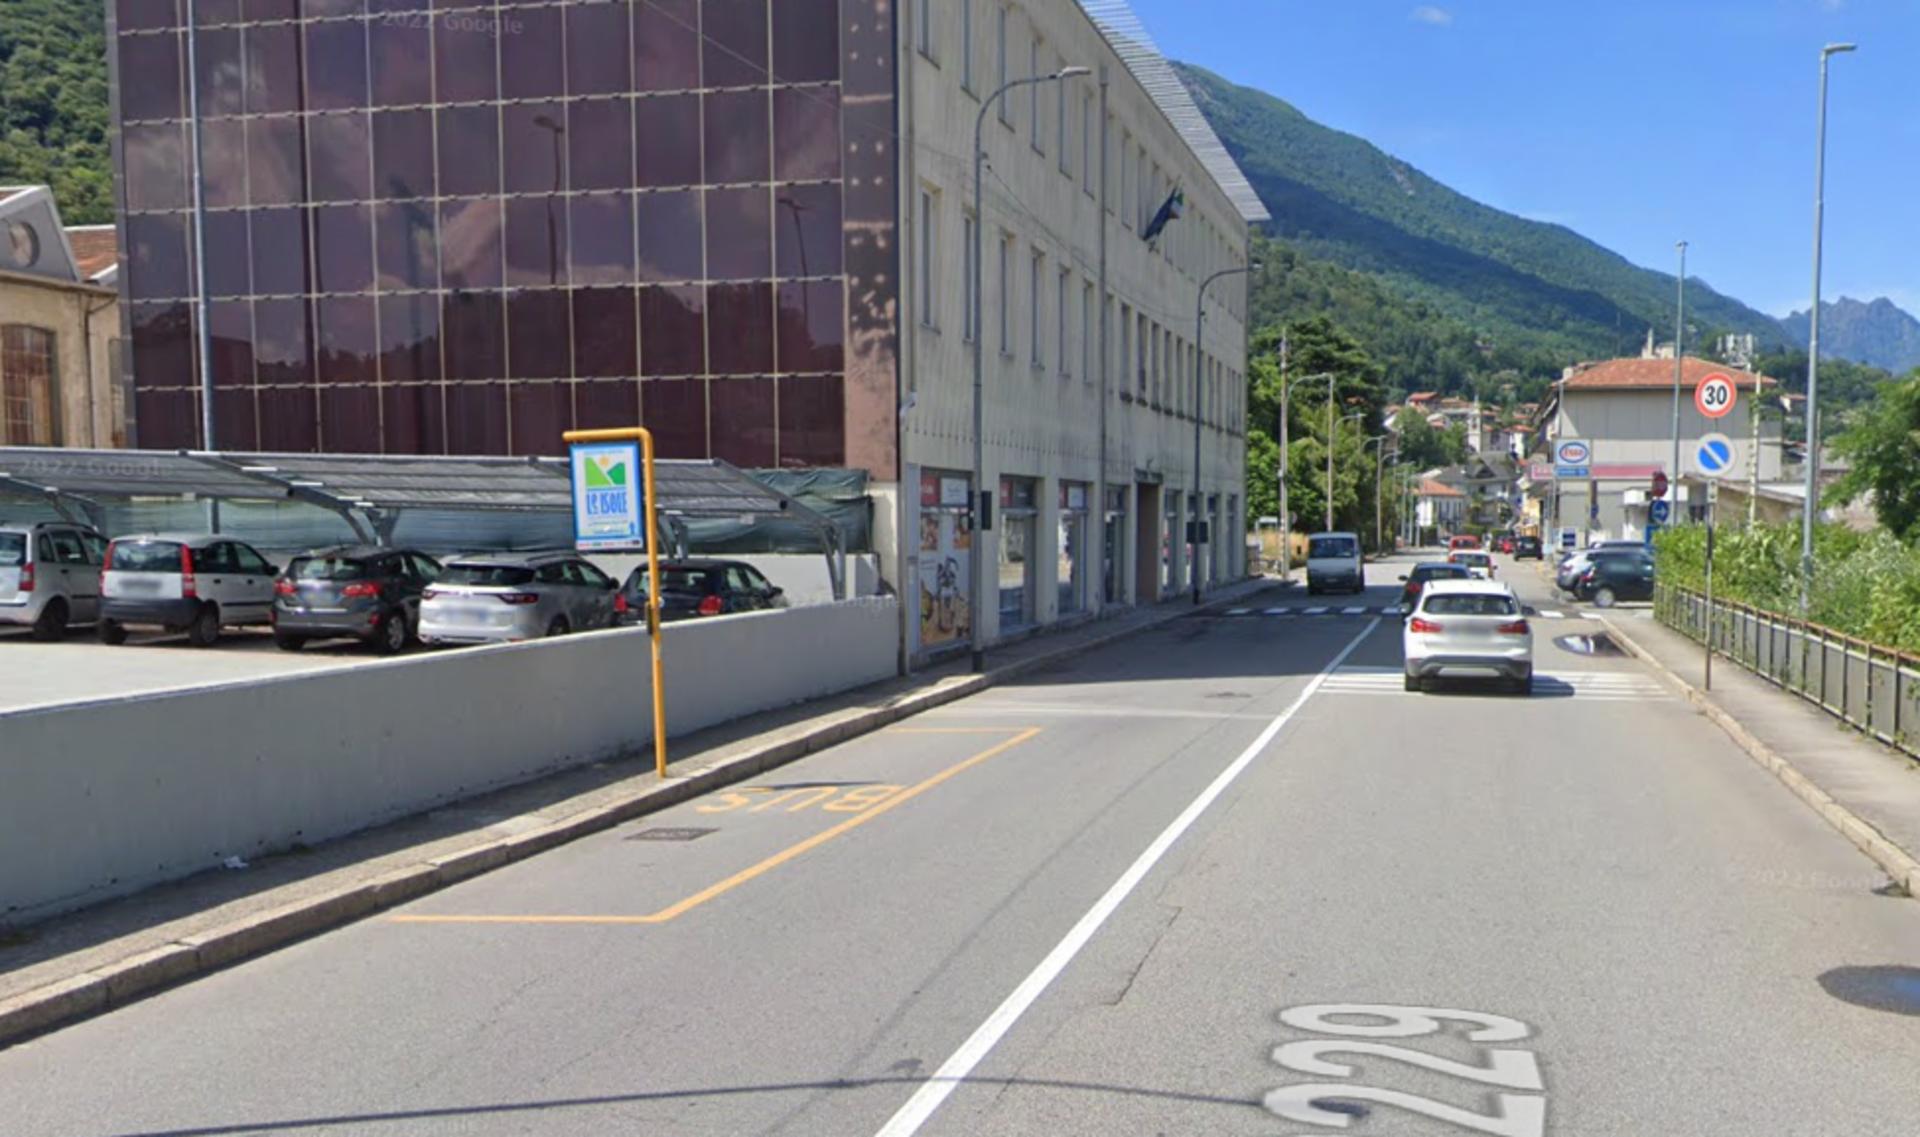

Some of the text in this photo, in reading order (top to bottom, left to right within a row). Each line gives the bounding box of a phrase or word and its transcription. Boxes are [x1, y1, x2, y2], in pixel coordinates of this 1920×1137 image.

[1704, 385, 1728, 405] 30
[695, 784, 904, 814] BUS
[1264, 1003, 1546, 1137] 229
